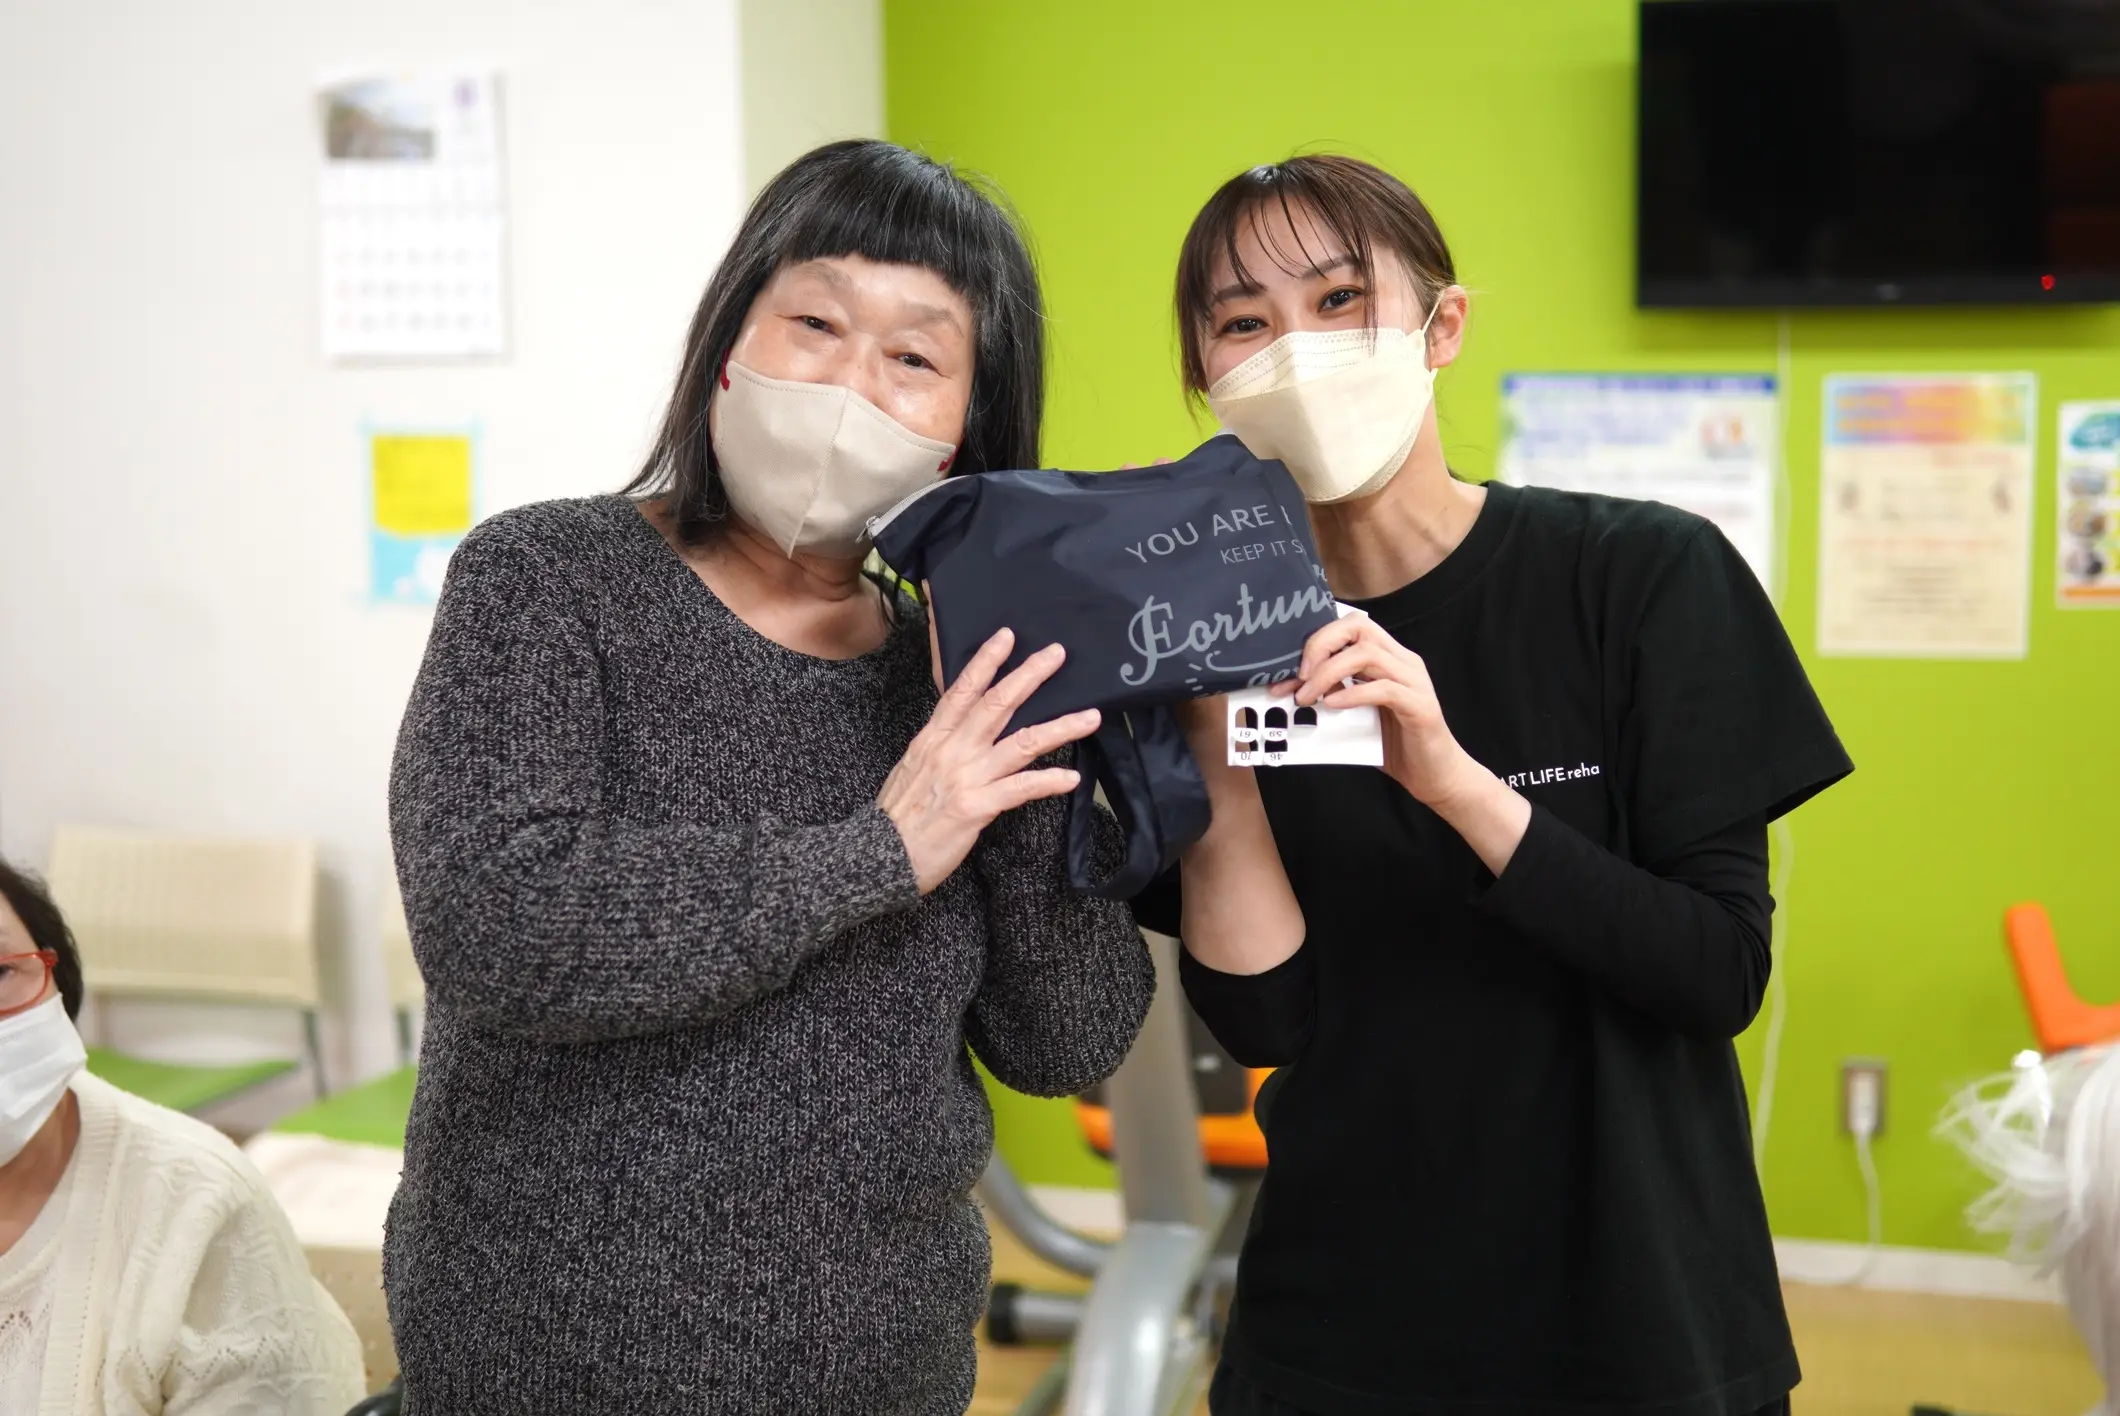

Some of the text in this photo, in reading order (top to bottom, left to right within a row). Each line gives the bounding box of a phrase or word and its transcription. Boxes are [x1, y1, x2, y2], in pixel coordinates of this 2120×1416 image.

[1124, 521, 1200, 564] YOU
[1212, 504, 1275, 537] ARE
[1220, 538, 1308, 565] KEEP IT S
[1500, 762, 1601, 788] RT LIFE reha
